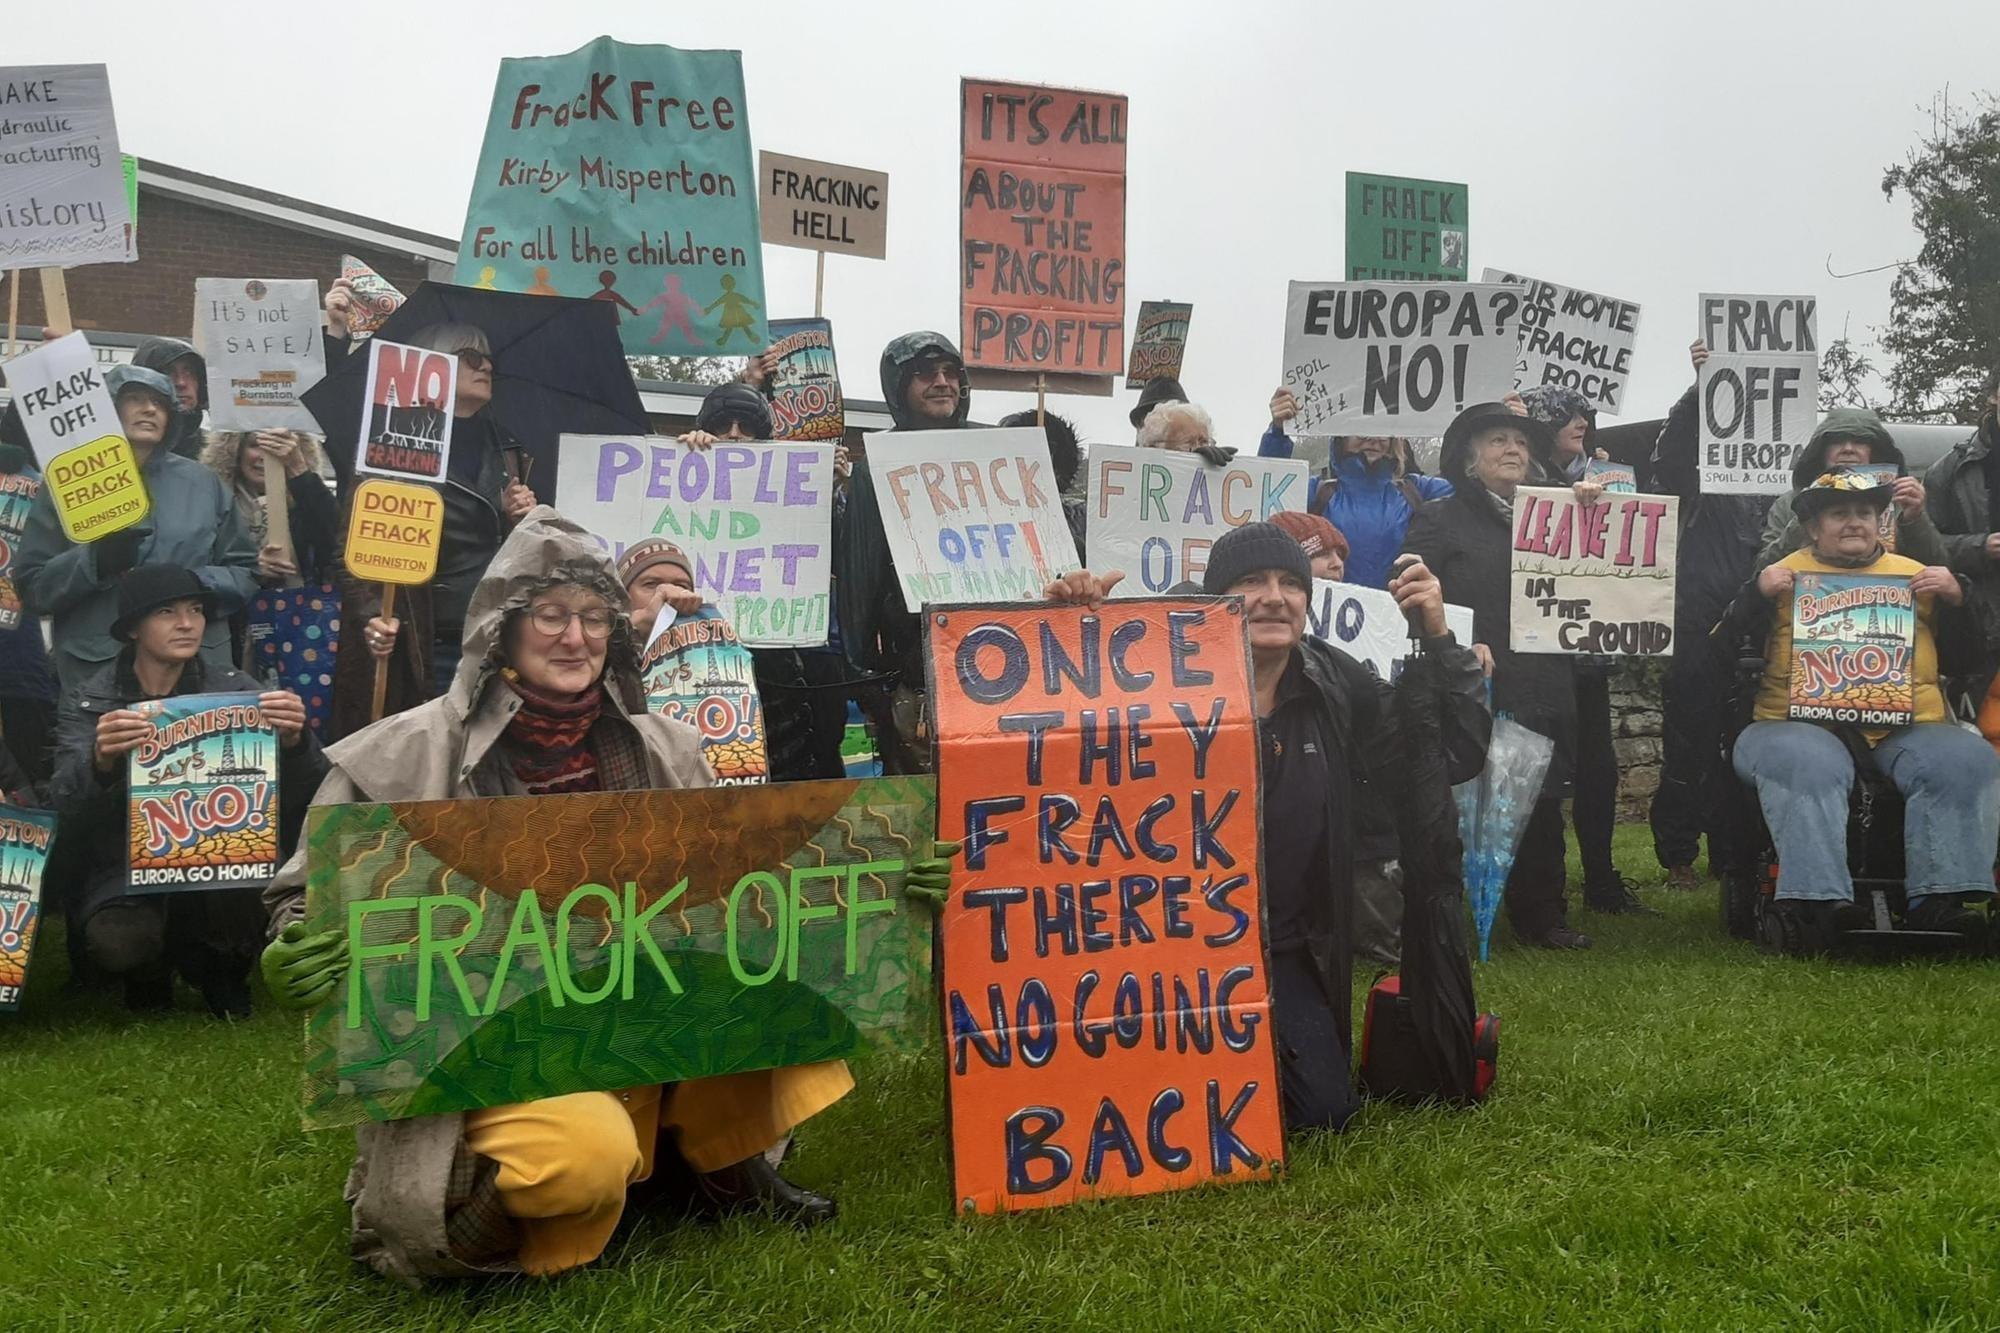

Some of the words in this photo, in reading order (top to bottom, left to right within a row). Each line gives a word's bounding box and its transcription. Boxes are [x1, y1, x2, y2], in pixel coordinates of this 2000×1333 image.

[0, 80, 58, 104] AKE
[630, 81, 735, 131] Free
[0, 116, 73, 137] draulic
[982, 92, 1054, 145] IT'S
[1061, 100, 1126, 144] ALL
[0, 141, 101, 168] acturing
[499, 158, 571, 194] Kirby
[580, 154, 737, 203] Misperton
[772, 168, 880, 211] FRACKING
[964, 167, 1086, 217] ABOUT
[0, 197, 107, 233] istory
[1362, 183, 1456, 224] FRACK
[473, 227, 514, 258] For
[520, 225, 558, 261] all
[571, 226, 619, 266] the
[627, 230, 746, 267] children
[793, 209, 855, 244] HELL
[1011, 215, 1093, 251] THE
[1382, 227, 1436, 263] OFF
[965, 239, 1124, 304] FRACKING
[211, 300, 246, 321] It's
[258, 302, 290, 323] not
[1303, 289, 1519, 340] EUROPA?
[1521, 302, 1556, 328] OT
[1560, 288, 1639, 333] HOME
[1705, 299, 1816, 352] FRACK
[227, 328, 313, 357] SAFE!
[775, 330, 830, 359] RNISTON
[973, 307, 1122, 367] PROFIT
[23, 368, 101, 415] FRACK
[375, 344, 451, 412] NO
[1286, 359, 1331, 385] SPOIL
[1363, 343, 1470, 416] NO!
[1541, 362, 1620, 407] ROCK
[1295, 384, 1328, 411] CASH
[1705, 367, 1801, 442] OFF
[50, 402, 98, 437] OFF!
[55, 445, 123, 484] DON'T
[366, 443, 442, 476] FRACKING
[596, 442, 820, 506] PEOPLE
[1705, 473, 1739, 483] SPOIL
[1757, 474, 1787, 484] CASH
[62, 469, 134, 509] FRACK
[363, 492, 437, 519] DON'T
[886, 456, 1048, 519] FRACK
[1099, 460, 1298, 527] FRACK
[72, 498, 141, 535] BURNISTON
[359, 520, 433, 545] FRACK
[651, 504, 761, 541] AND
[1514, 496, 1612, 560] LEAVE
[1614, 500, 1667, 567] IT
[354, 551, 428, 571] BURNISTON
[1141, 536, 1213, 593] OF
[1524, 578, 1556, 598] IN
[1798, 584, 1913, 623] BURNISTON
[734, 593, 828, 637] PROFIT
[1536, 598, 1591, 620] THE
[1807, 617, 1856, 640] SAYS
[640, 618, 738, 672] URNISTO
[955, 611, 1214, 705] ONCE
[1558, 620, 1672, 655] GROUND
[1800, 644, 1906, 693] NO!
[1790, 704, 1834, 721] EUROPA
[1835, 708, 1859, 722] GO
[1861, 709, 1912, 726] HOME!
[998, 697, 1226, 786] THEY
[148, 750, 207, 785] SAYS
[715, 775, 767, 788] OME!
[140, 780, 268, 852] NO!
[965, 789, 1241, 870] FRACK
[131, 867, 187, 886] EUROPA
[187, 865, 214, 882] GO
[217, 863, 276, 880] HOME!
[963, 873, 1250, 962] THERE'S
[347, 877, 689, 1028] FRACK
[726, 860, 905, 986] OFF
[950, 978, 1057, 1076] NO
[1073, 965, 1262, 1058] GOING
[1006, 1080, 1263, 1195] BACK
